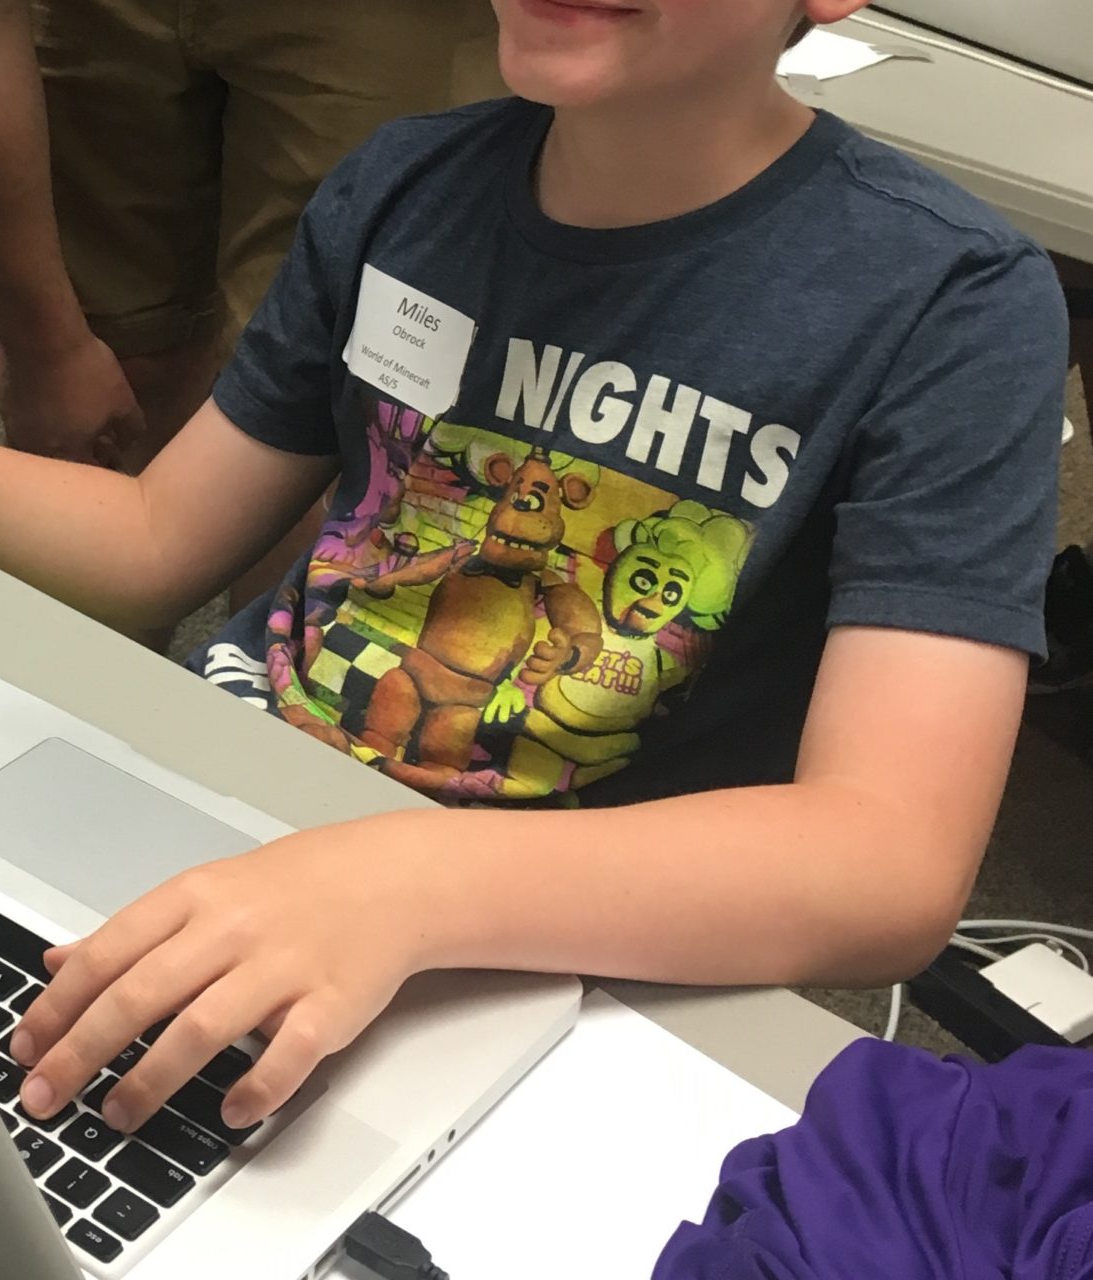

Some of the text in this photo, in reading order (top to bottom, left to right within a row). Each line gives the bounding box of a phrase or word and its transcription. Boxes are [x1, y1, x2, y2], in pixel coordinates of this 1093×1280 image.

[396, 297, 442, 332] Miles
[392, 325, 427, 350] Obrock
[361, 344, 431, 390] World of Minecraft
[495, 337, 802, 509] NIGHTS
[83, 1126, 98, 1139] Q
[168, 1169, 184, 1182] tab
[85, 1230, 103, 1244] esc
